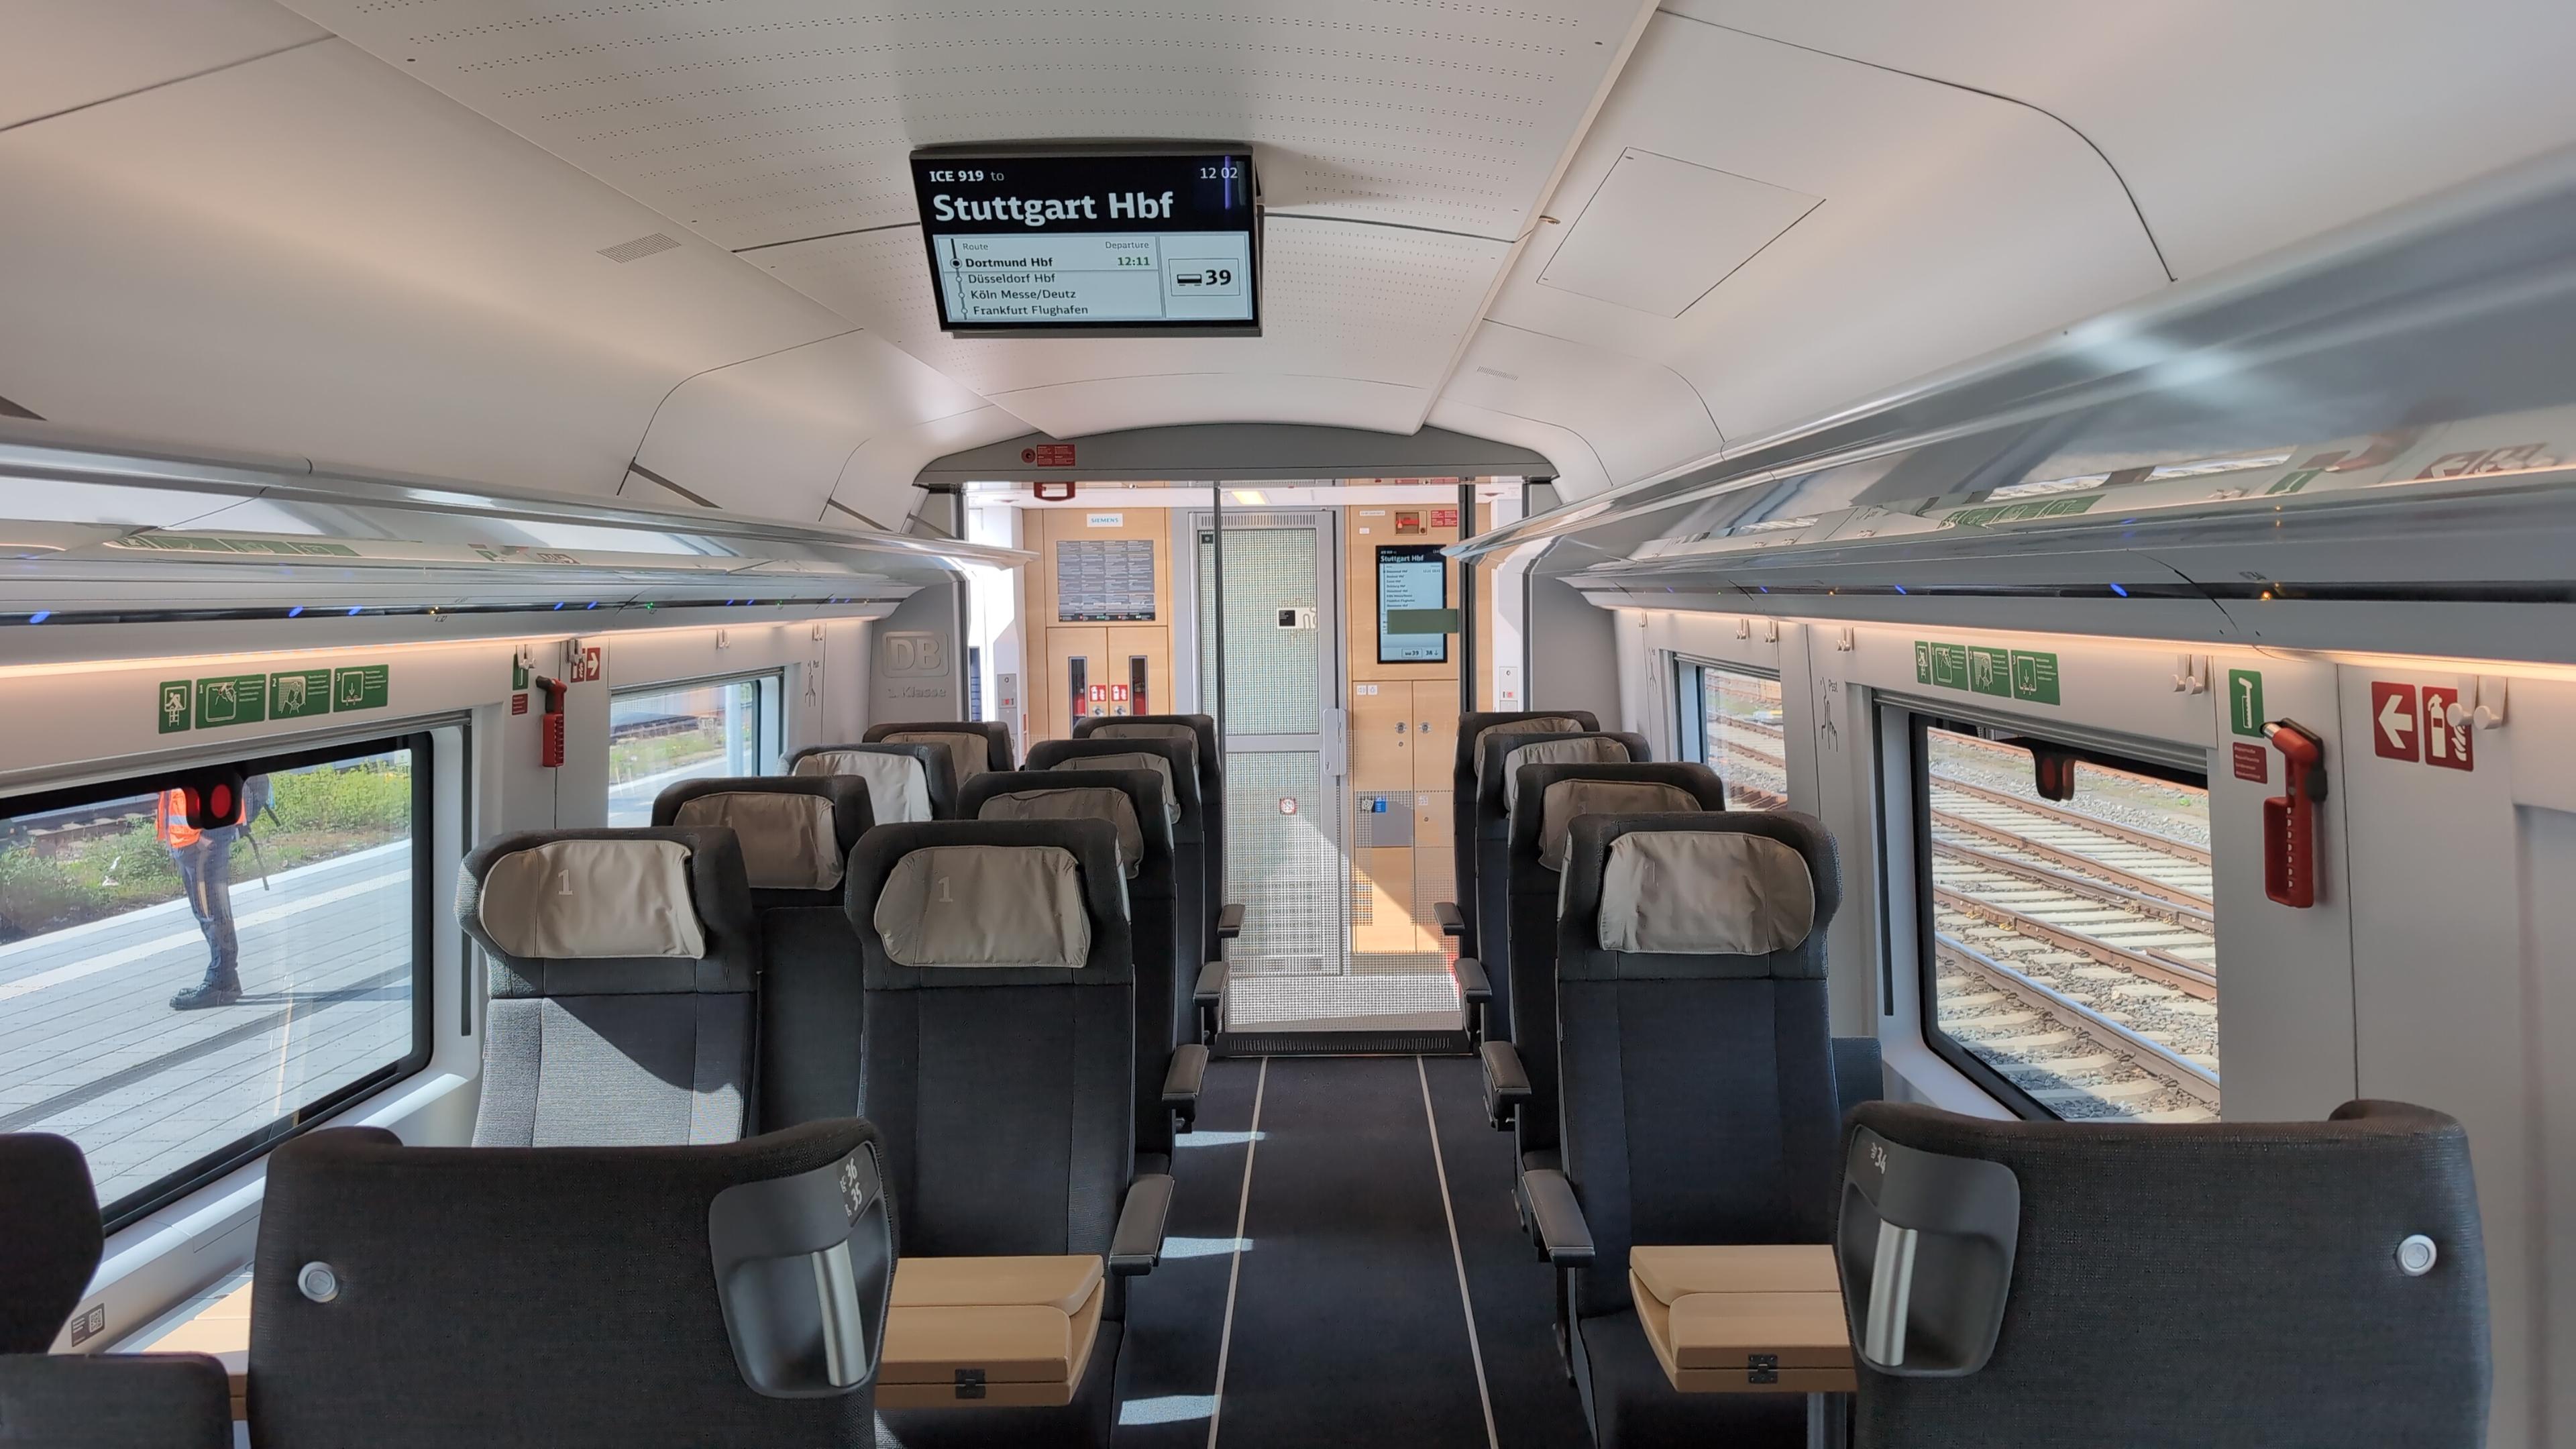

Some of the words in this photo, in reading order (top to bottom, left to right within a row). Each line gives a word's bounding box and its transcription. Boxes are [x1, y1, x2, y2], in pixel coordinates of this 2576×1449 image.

[929, 170, 955, 182] ICE
[958, 170, 984, 181] 919
[990, 171, 1005, 181] to
[933, 194, 1097, 227] Stuttgart
[1108, 191, 1173, 219] Hbf
[1105, 241, 1149, 250] Departure
[965, 258, 1027, 268] Dortmund
[1031, 257, 1053, 267] Hbf
[1118, 256, 1150, 266] 12:11
[968, 274, 1030, 284] Düsseldorf
[1034, 273, 1056, 283] Hbf
[1205, 270, 1232, 286] 39
[971, 290, 998, 299] Köln
[1001, 289, 1077, 301] Messe/Deutz
[973, 306, 1028, 315] Frankfurt
[1032, 305, 1088, 317] Flughafen
[890, 637, 941, 669] DB
[199, 684, 203, 694] 1
[272, 678, 277, 688] 2
[903, 687, 946, 698] Klasse
[558, 869, 574, 895] 1
[938, 875, 954, 902] 1
[1875, 1147, 1886, 1174] 34
[846, 1157, 857, 1187] 36
[851, 1183, 862, 1211] 35
